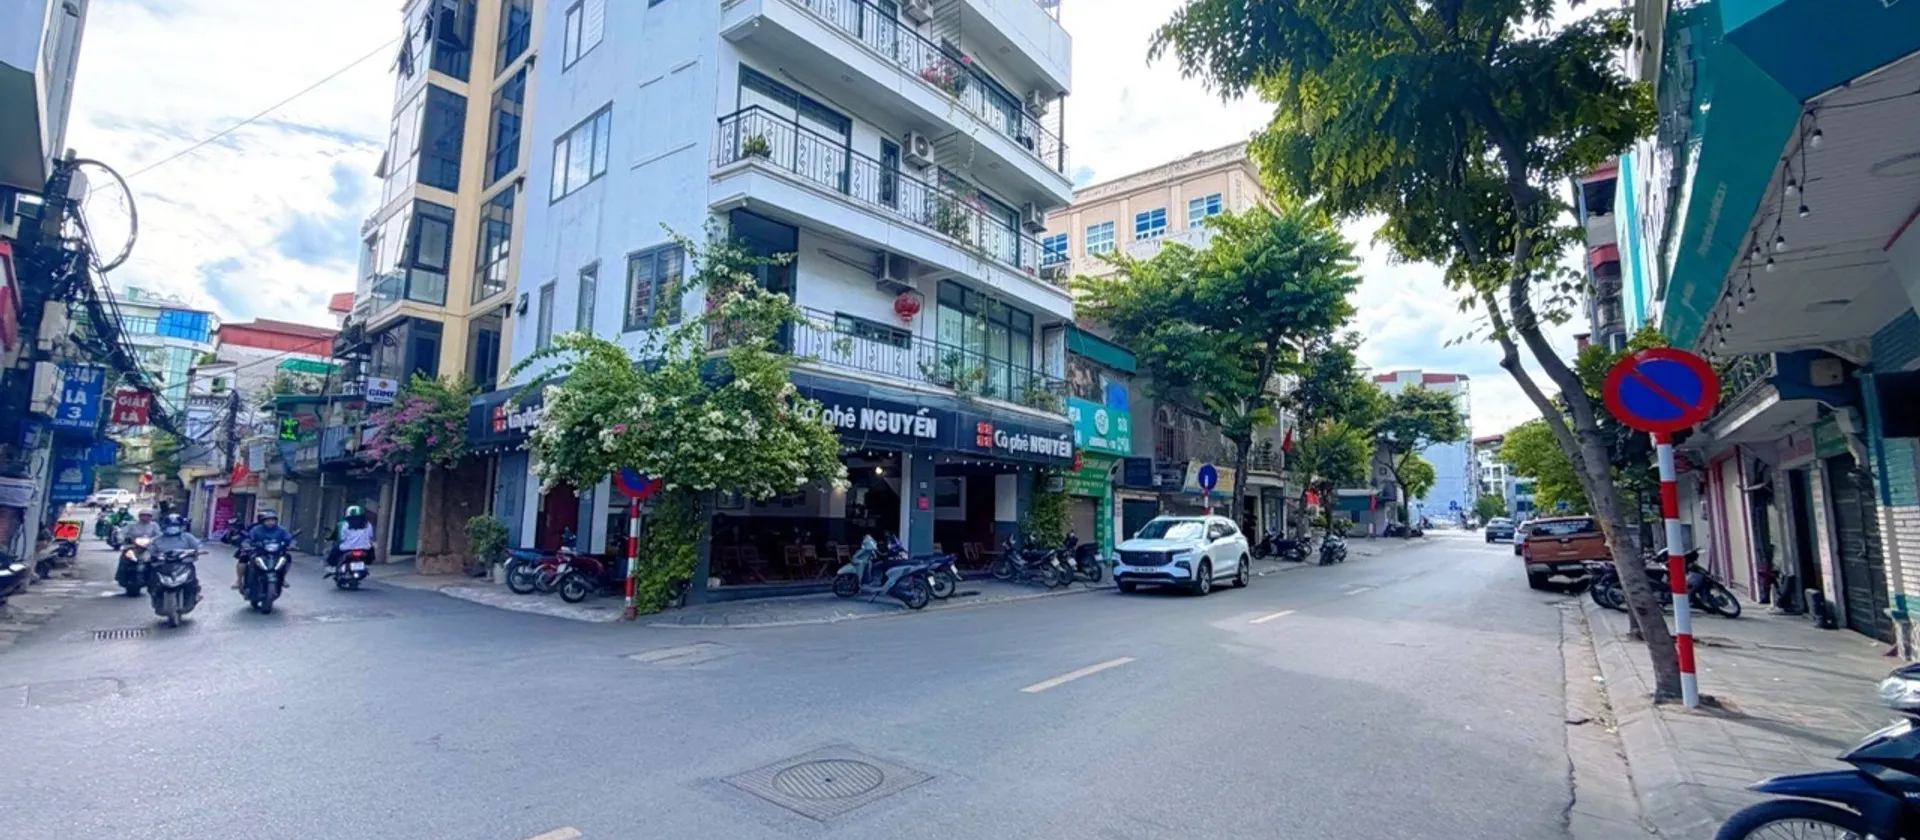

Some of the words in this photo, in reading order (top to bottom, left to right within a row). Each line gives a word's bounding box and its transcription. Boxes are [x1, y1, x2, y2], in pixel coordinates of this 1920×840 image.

[66, 387, 87, 405] LÀ
[67, 406, 82, 419] 3
[822, 404, 857, 429] phê
[1010, 433, 1029, 454] phê
